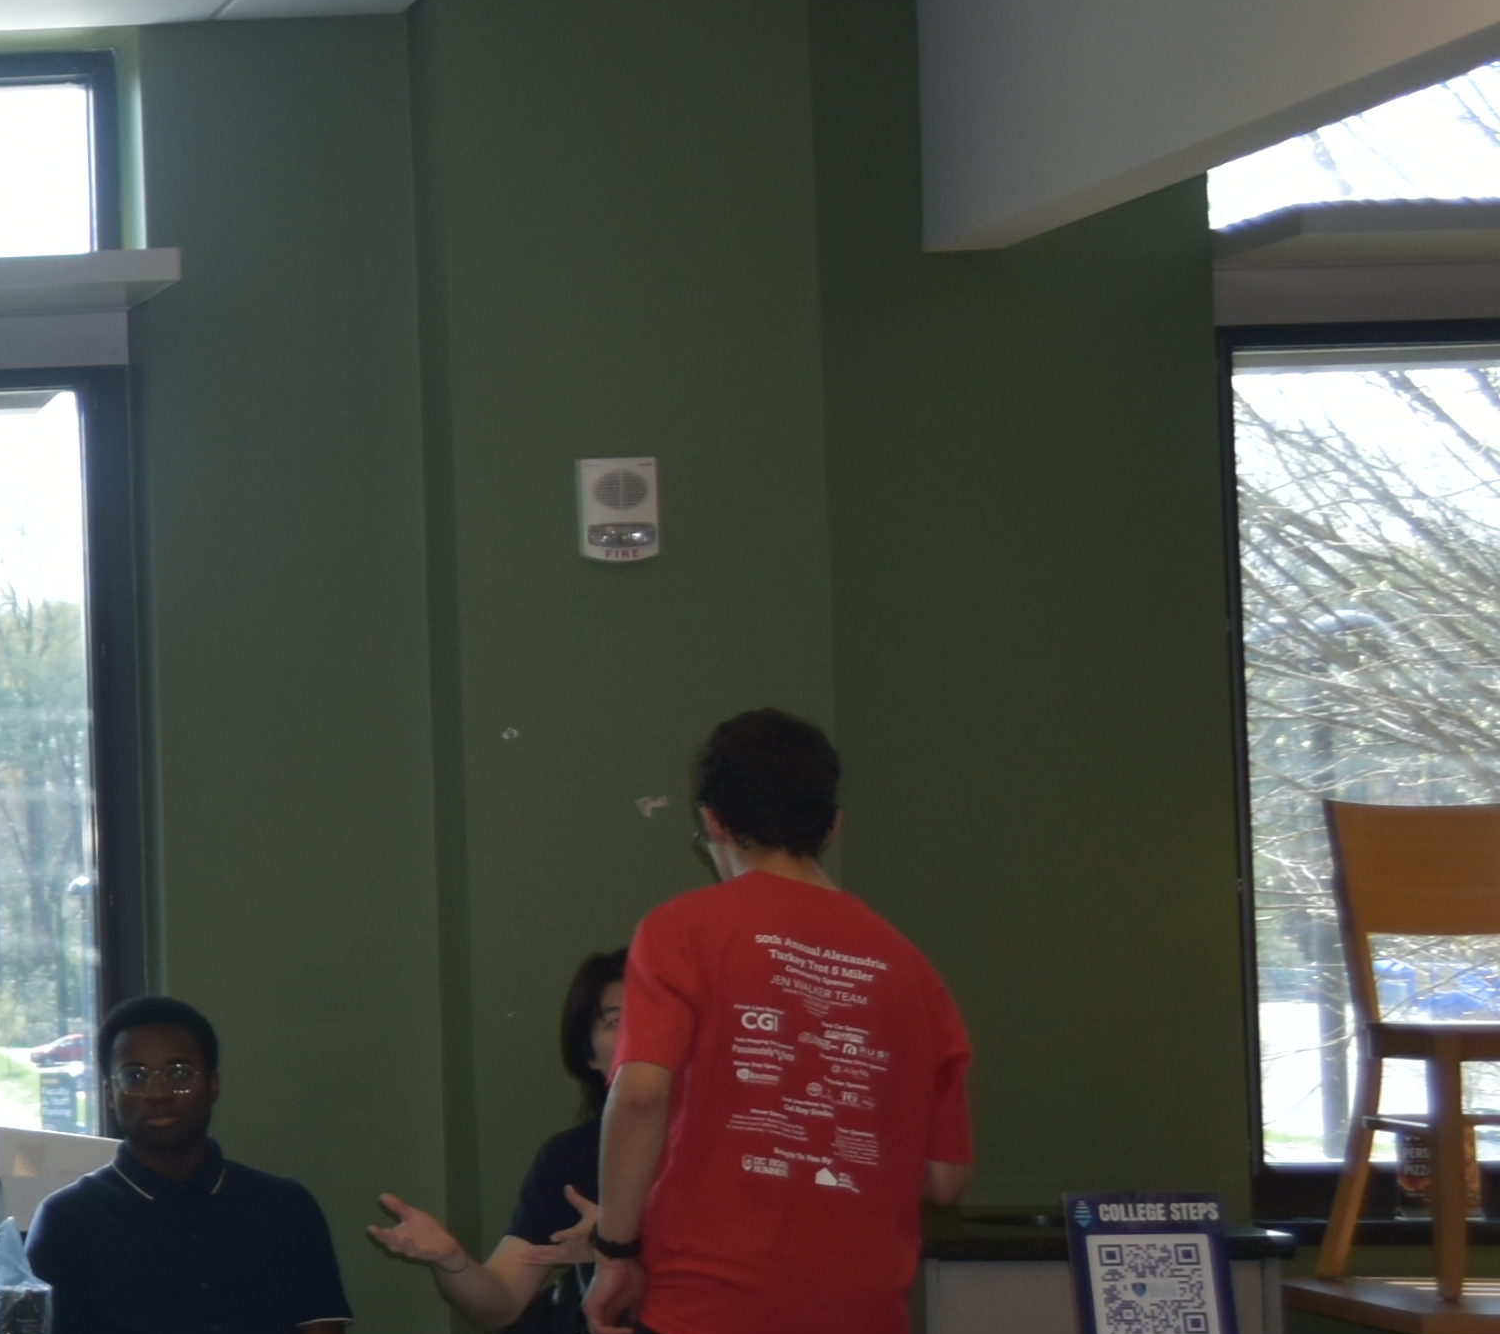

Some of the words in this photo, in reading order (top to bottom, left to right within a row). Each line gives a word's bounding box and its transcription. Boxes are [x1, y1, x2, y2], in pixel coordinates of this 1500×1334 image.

[605, 549, 640, 559] FIRE
[754, 934, 782, 945] 50th
[784, 937, 821, 957] Annual
[822, 949, 887, 970] Alexandria
[768, 948, 806, 968] Turkey
[807, 959, 829, 974] Trot
[841, 966, 875, 982] Miler
[770, 974, 791, 987] JEN
[793, 978, 832, 999] WALKER
[835, 989, 868, 1005] TEAM
[741, 1011, 779, 1032] CGI
[1098, 1203, 1167, 1222] COLLEGE
[1170, 1202, 1219, 1221] STEPS
